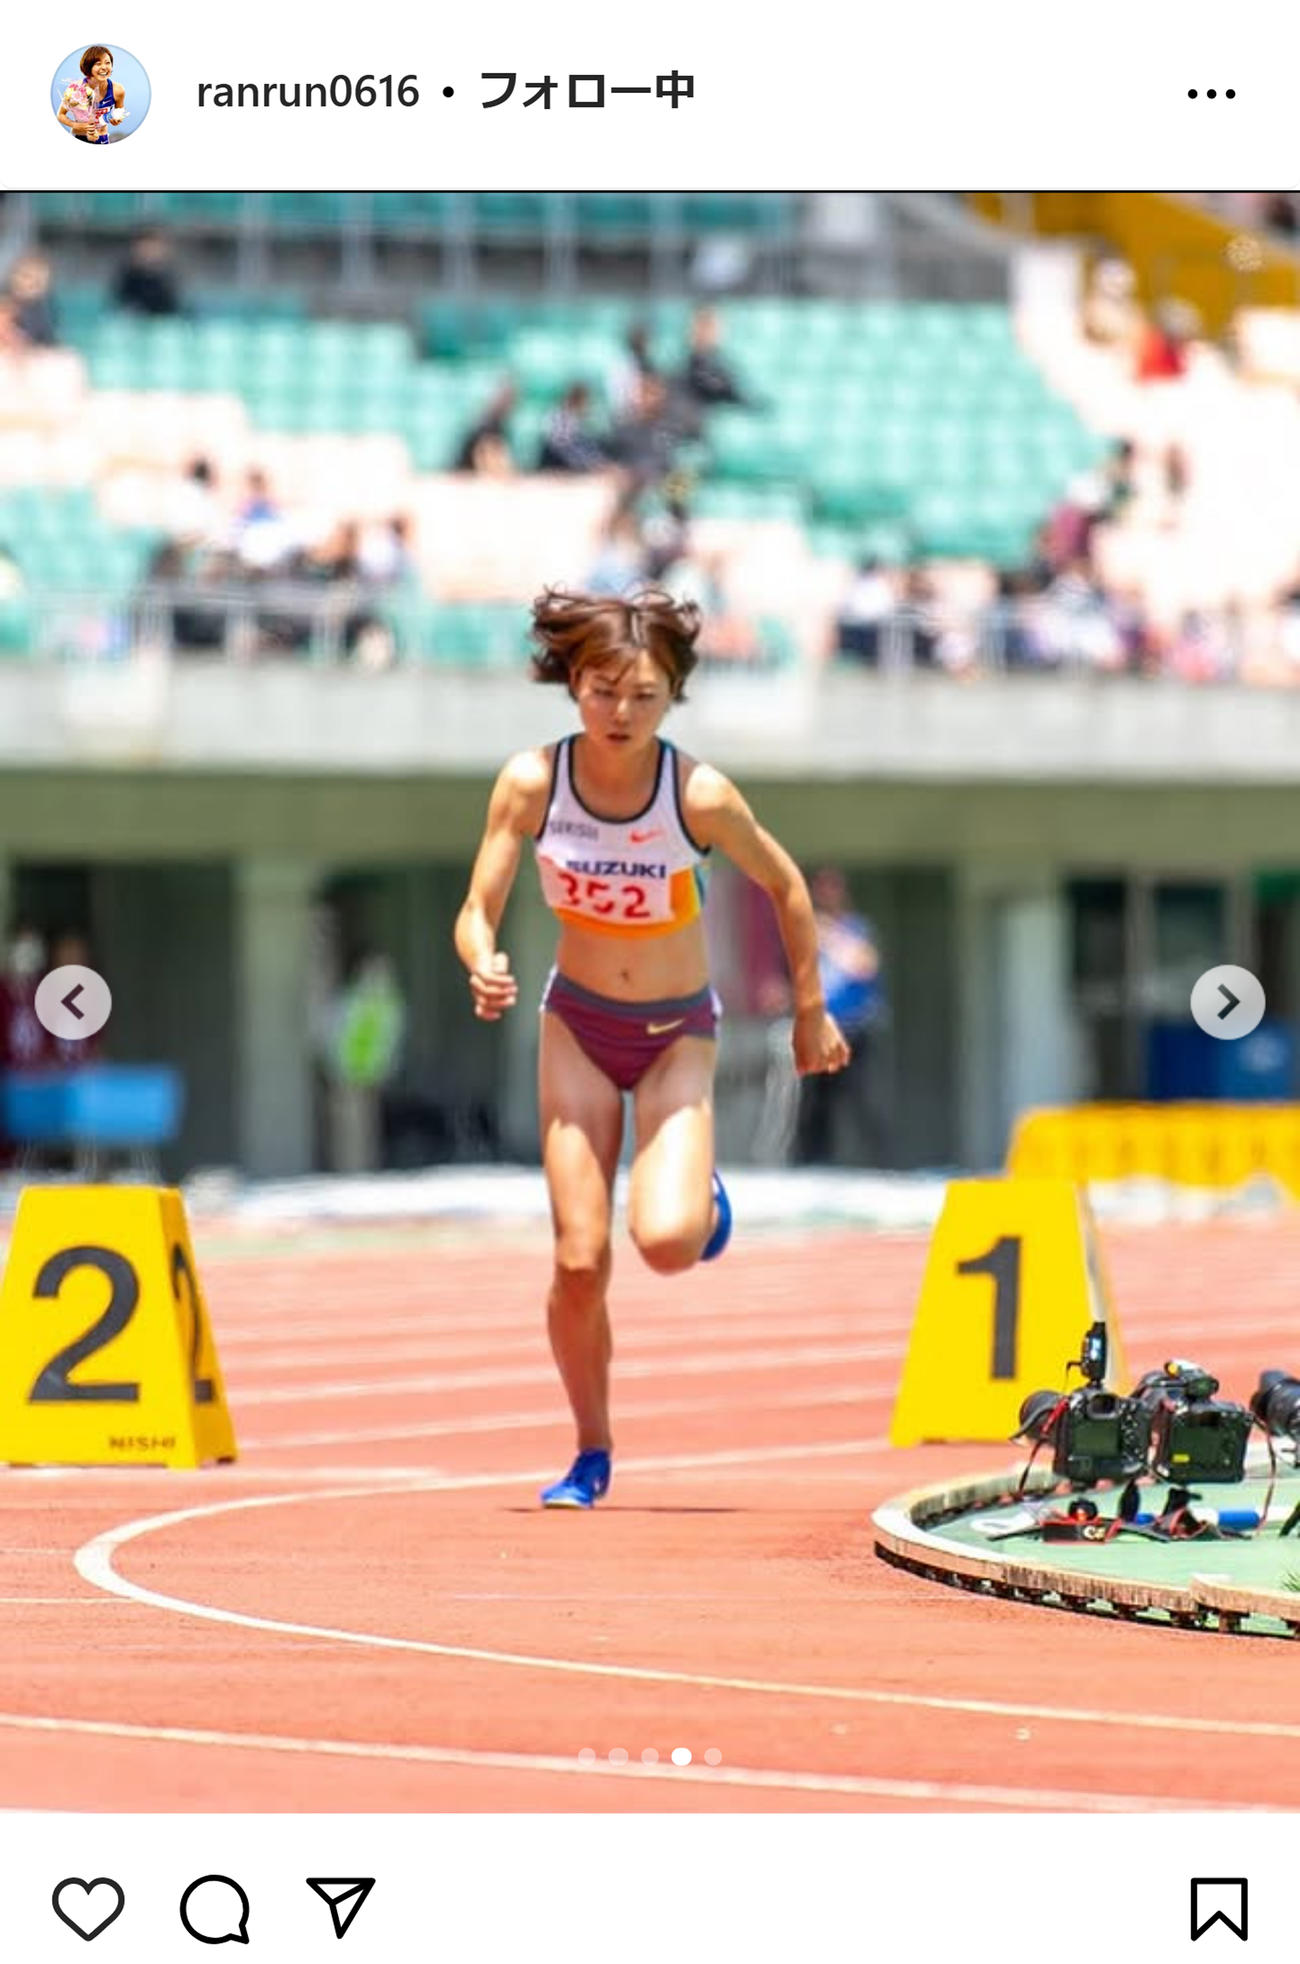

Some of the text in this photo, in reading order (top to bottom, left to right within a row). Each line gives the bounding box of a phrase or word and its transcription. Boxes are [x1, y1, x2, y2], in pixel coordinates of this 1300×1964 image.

[558, 870, 650, 919] 352
[566, 861, 665, 879] SUZUKI
[28, 1246, 140, 1404] 2
[956, 1236, 1022, 1380] 1
